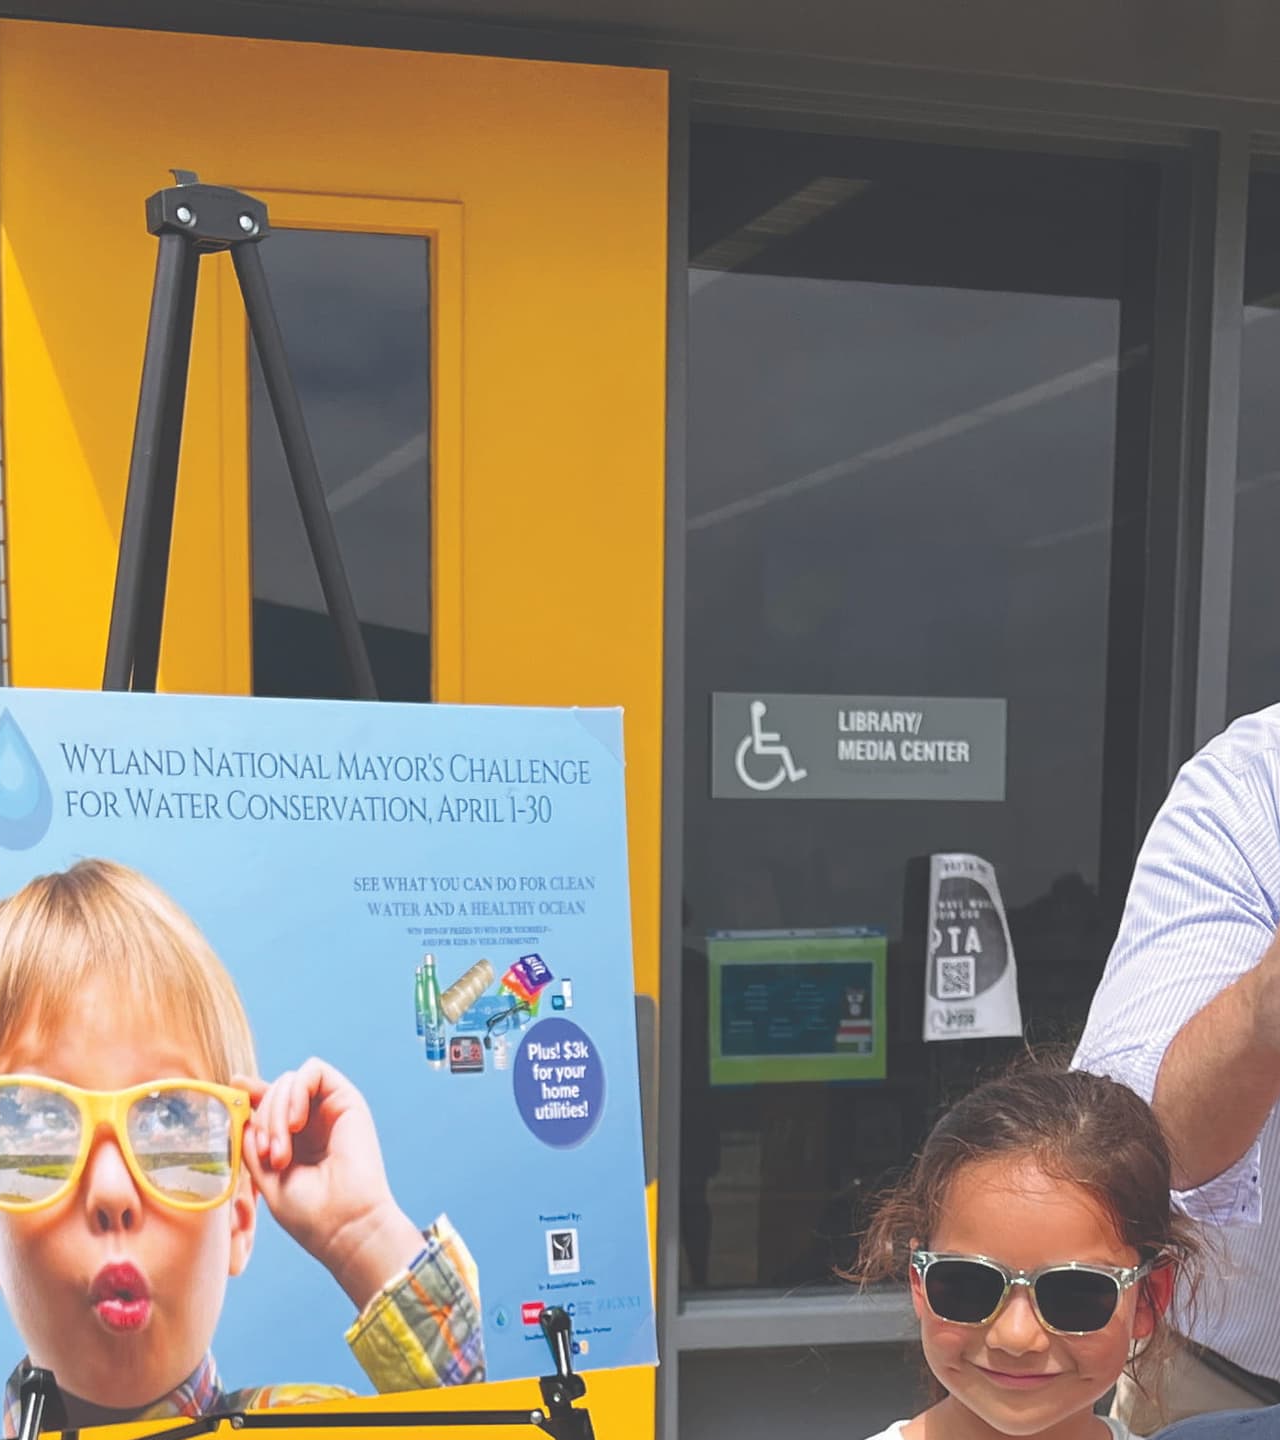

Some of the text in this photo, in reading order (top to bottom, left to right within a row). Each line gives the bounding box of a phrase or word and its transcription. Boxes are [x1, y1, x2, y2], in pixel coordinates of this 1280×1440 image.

[838, 711, 923, 735] LIBRARY/
[838, 740, 970, 762] MEDIA CENTER
[60, 742, 592, 785] WYLAND NATIONAL MAYOR'S CHALLENGE
[65, 790, 121, 818] FOR
[124, 787, 223, 819] WATER
[438, 794, 505, 823] APRIL
[510, 795, 553, 825] 1-30
[353, 875, 596, 892] SEE WHAT YOU CAN DO FOR CLEAN
[368, 900, 587, 917] WATER AND A HEALTHY OCEAN
[527, 1040, 589, 1060] Plus! $3k
[533, 1063, 586, 1083] for your
[542, 1083, 580, 1099] home
[535, 1100, 589, 1120] utilities!
